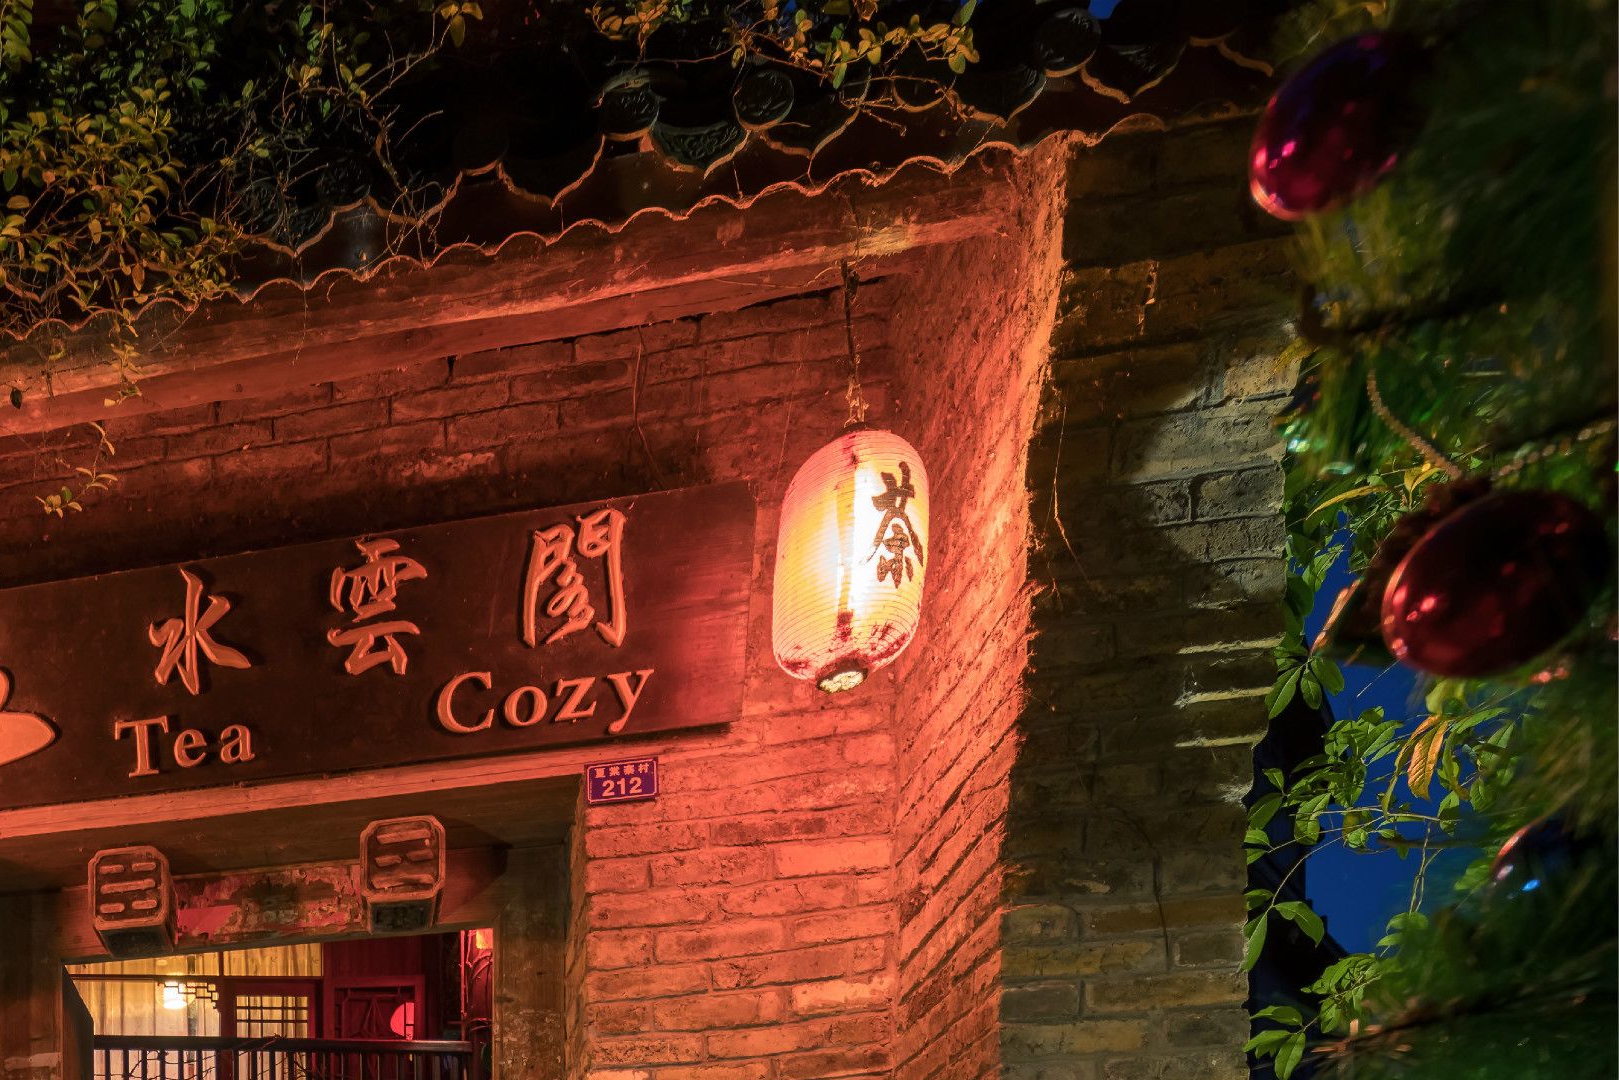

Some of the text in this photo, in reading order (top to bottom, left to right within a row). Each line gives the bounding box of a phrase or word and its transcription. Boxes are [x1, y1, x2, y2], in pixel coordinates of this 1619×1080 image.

[865, 461, 924, 589] 茶
[114, 667, 655, 779] Tea Cozy
[602, 776, 643, 797] 212
